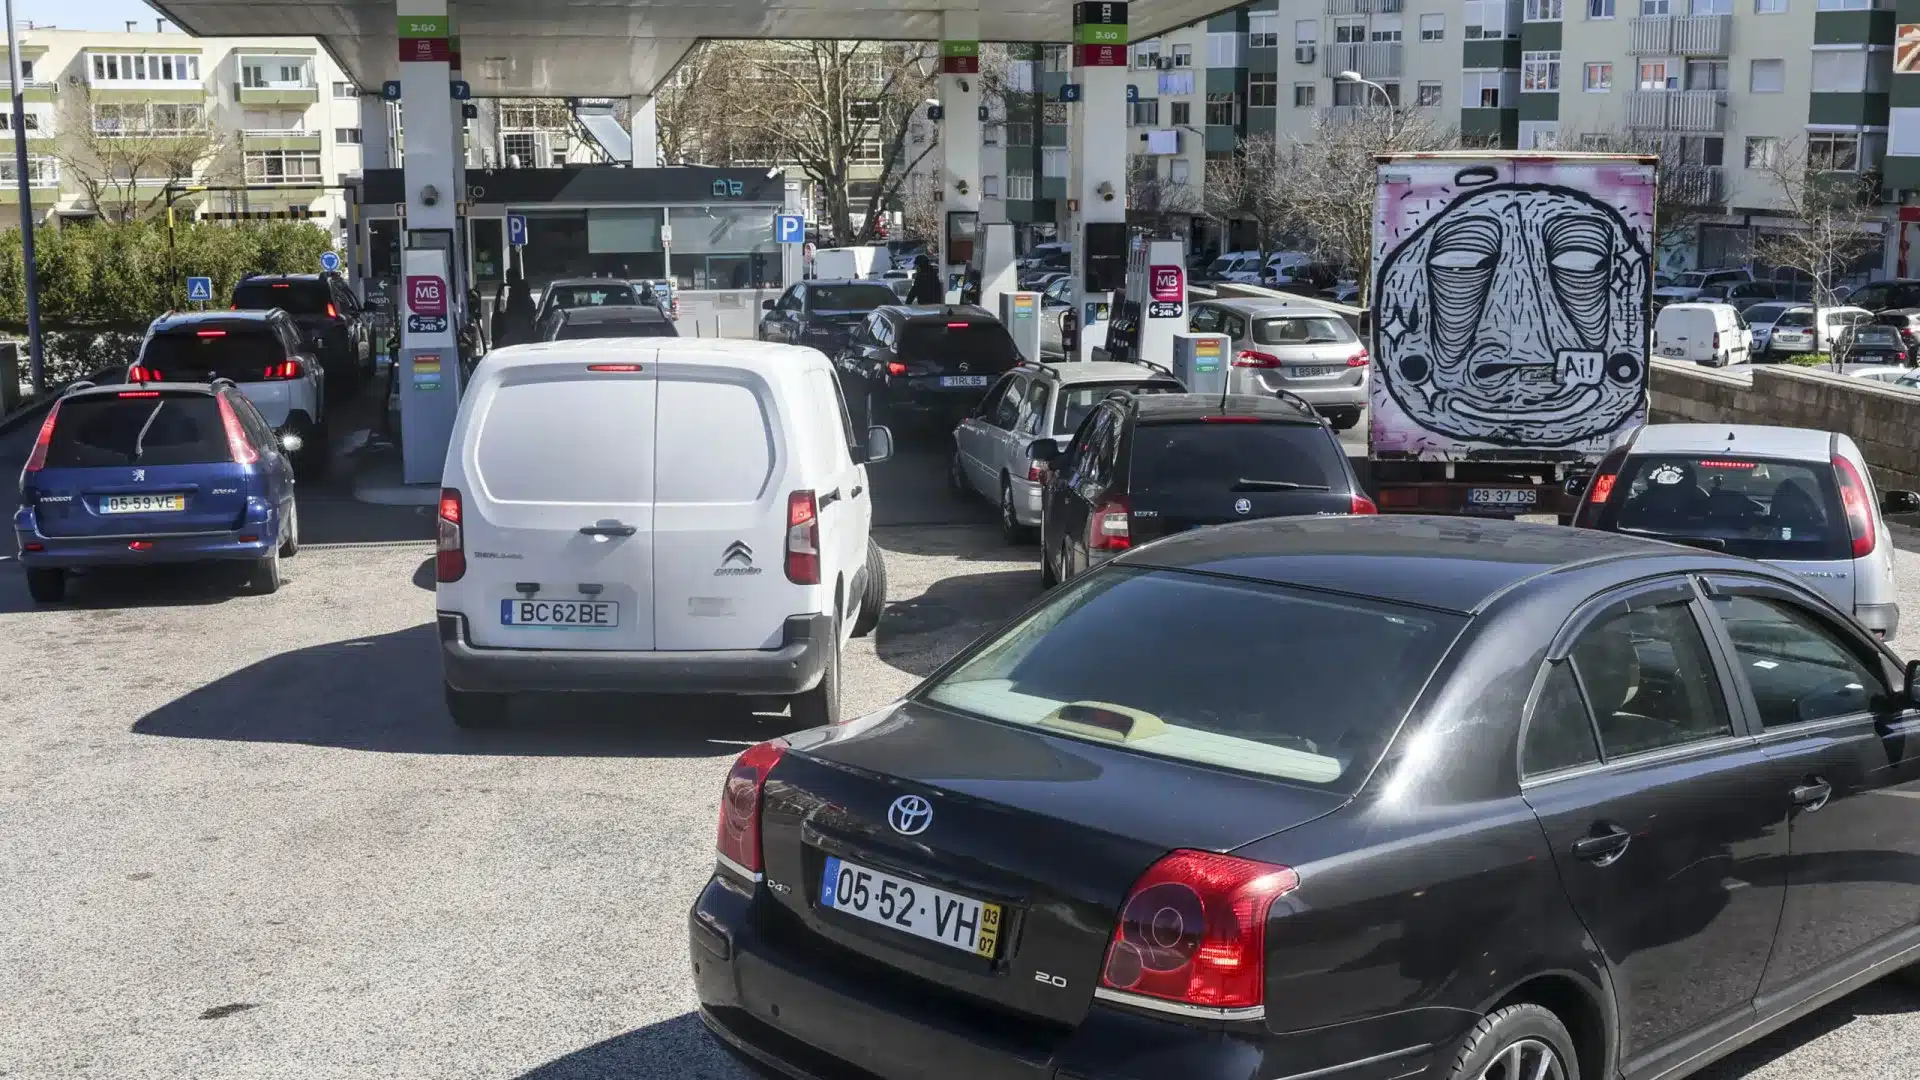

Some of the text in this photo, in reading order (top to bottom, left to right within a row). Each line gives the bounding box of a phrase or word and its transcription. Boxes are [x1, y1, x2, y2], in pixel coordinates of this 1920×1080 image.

[388, 85, 396, 96] 8
[456, 86, 464, 96] 7
[1067, 88, 1074, 98] 6
[1127, 88, 1133, 98] 5
[510, 218, 521, 241] P
[782, 217, 799, 241] P
[1156, 275, 1178, 287] MB
[415, 286, 439, 299] MB
[420, 323, 437, 331] 24h
[1565, 355, 1595, 378] Ai!
[984, 908, 998, 925] 03
[979, 936, 994, 953] 07
